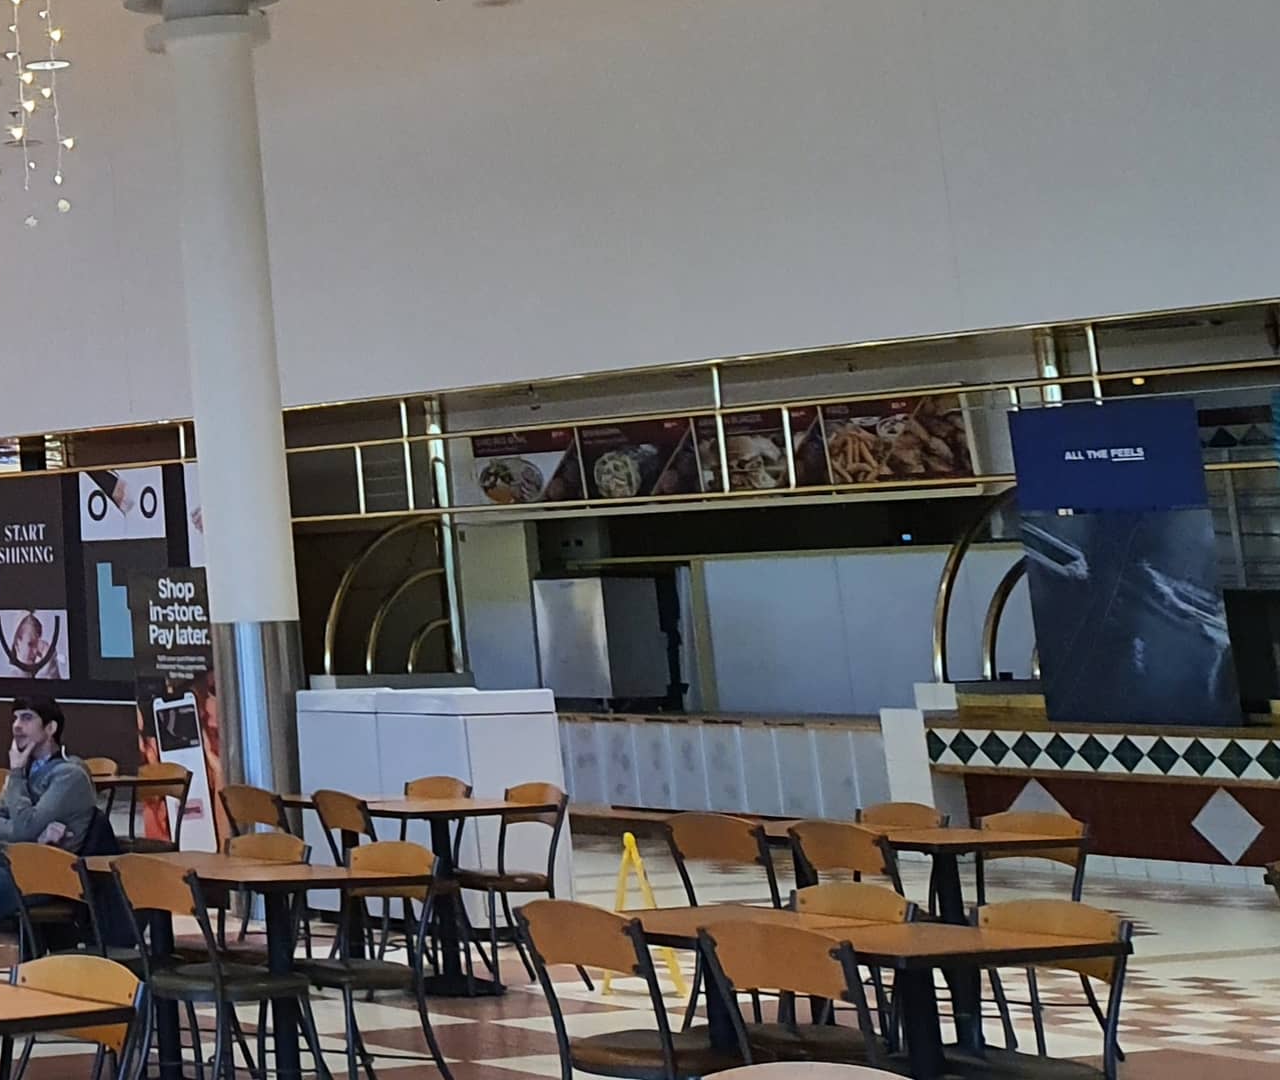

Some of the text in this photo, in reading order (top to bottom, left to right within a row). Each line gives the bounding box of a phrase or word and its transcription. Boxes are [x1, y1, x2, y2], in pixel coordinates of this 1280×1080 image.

[1065, 447, 1144, 461] ALL THE FEELS
[4, 523, 46, 542] START
[158, 577, 195, 602] Shop
[149, 600, 207, 622] in-store.
[149, 623, 211, 650] Pay later.
